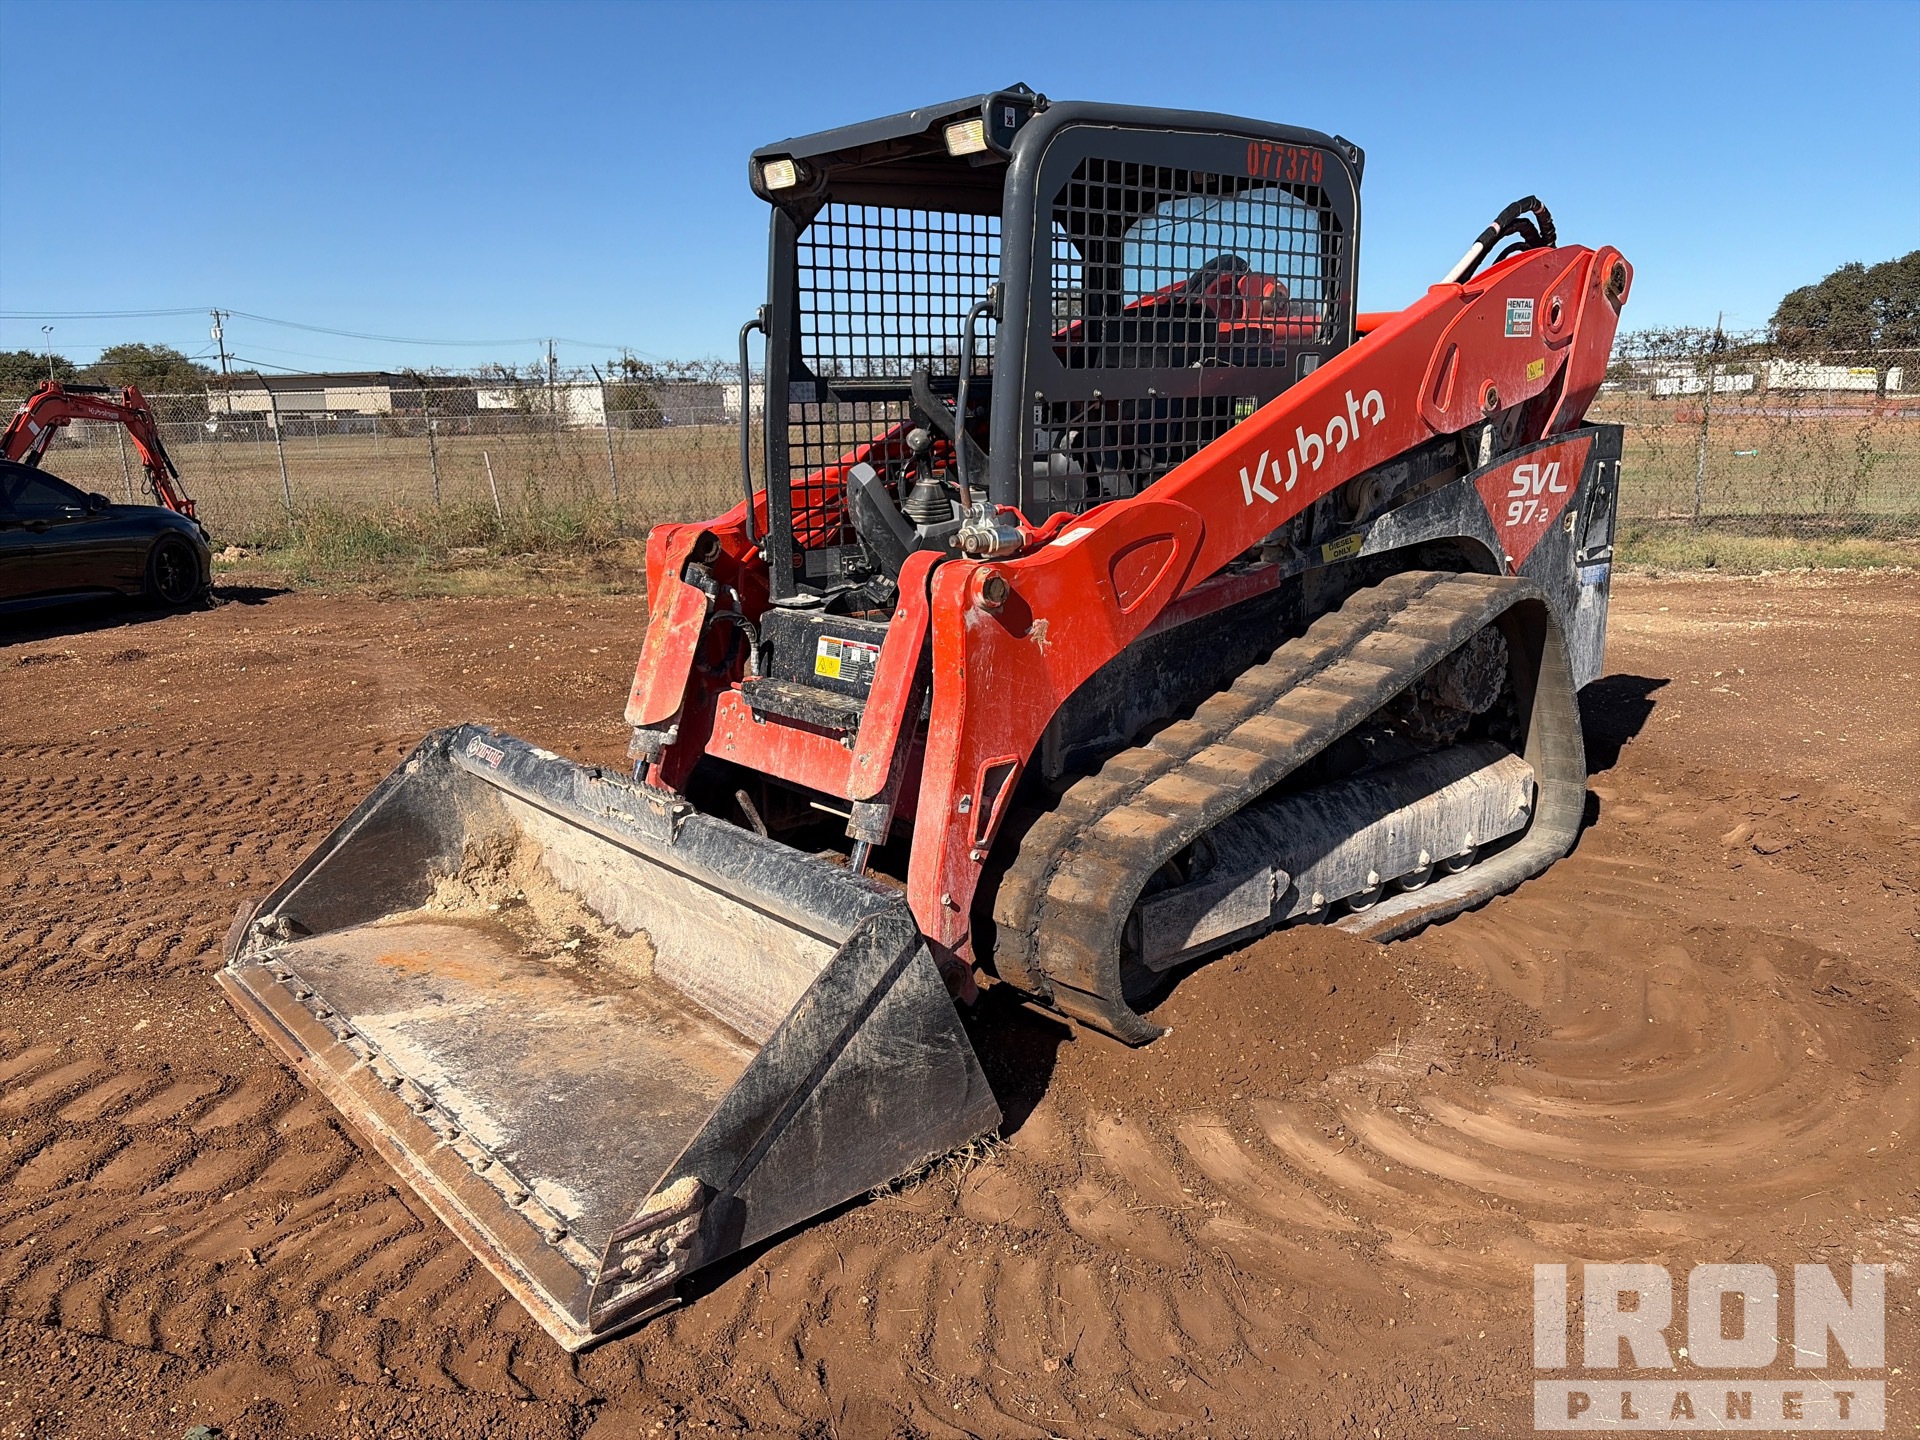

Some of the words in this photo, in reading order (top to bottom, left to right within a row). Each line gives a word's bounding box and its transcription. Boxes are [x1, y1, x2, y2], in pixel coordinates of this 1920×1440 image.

[1247, 141, 1323, 184] 077379
[1239, 389, 1386, 506] Kubota
[1507, 461, 1568, 498] SVL
[1505, 499, 1549, 527] 97-2
[1328, 536, 1355, 551] DIESEL
[1333, 546, 1352, 558] ONLY
